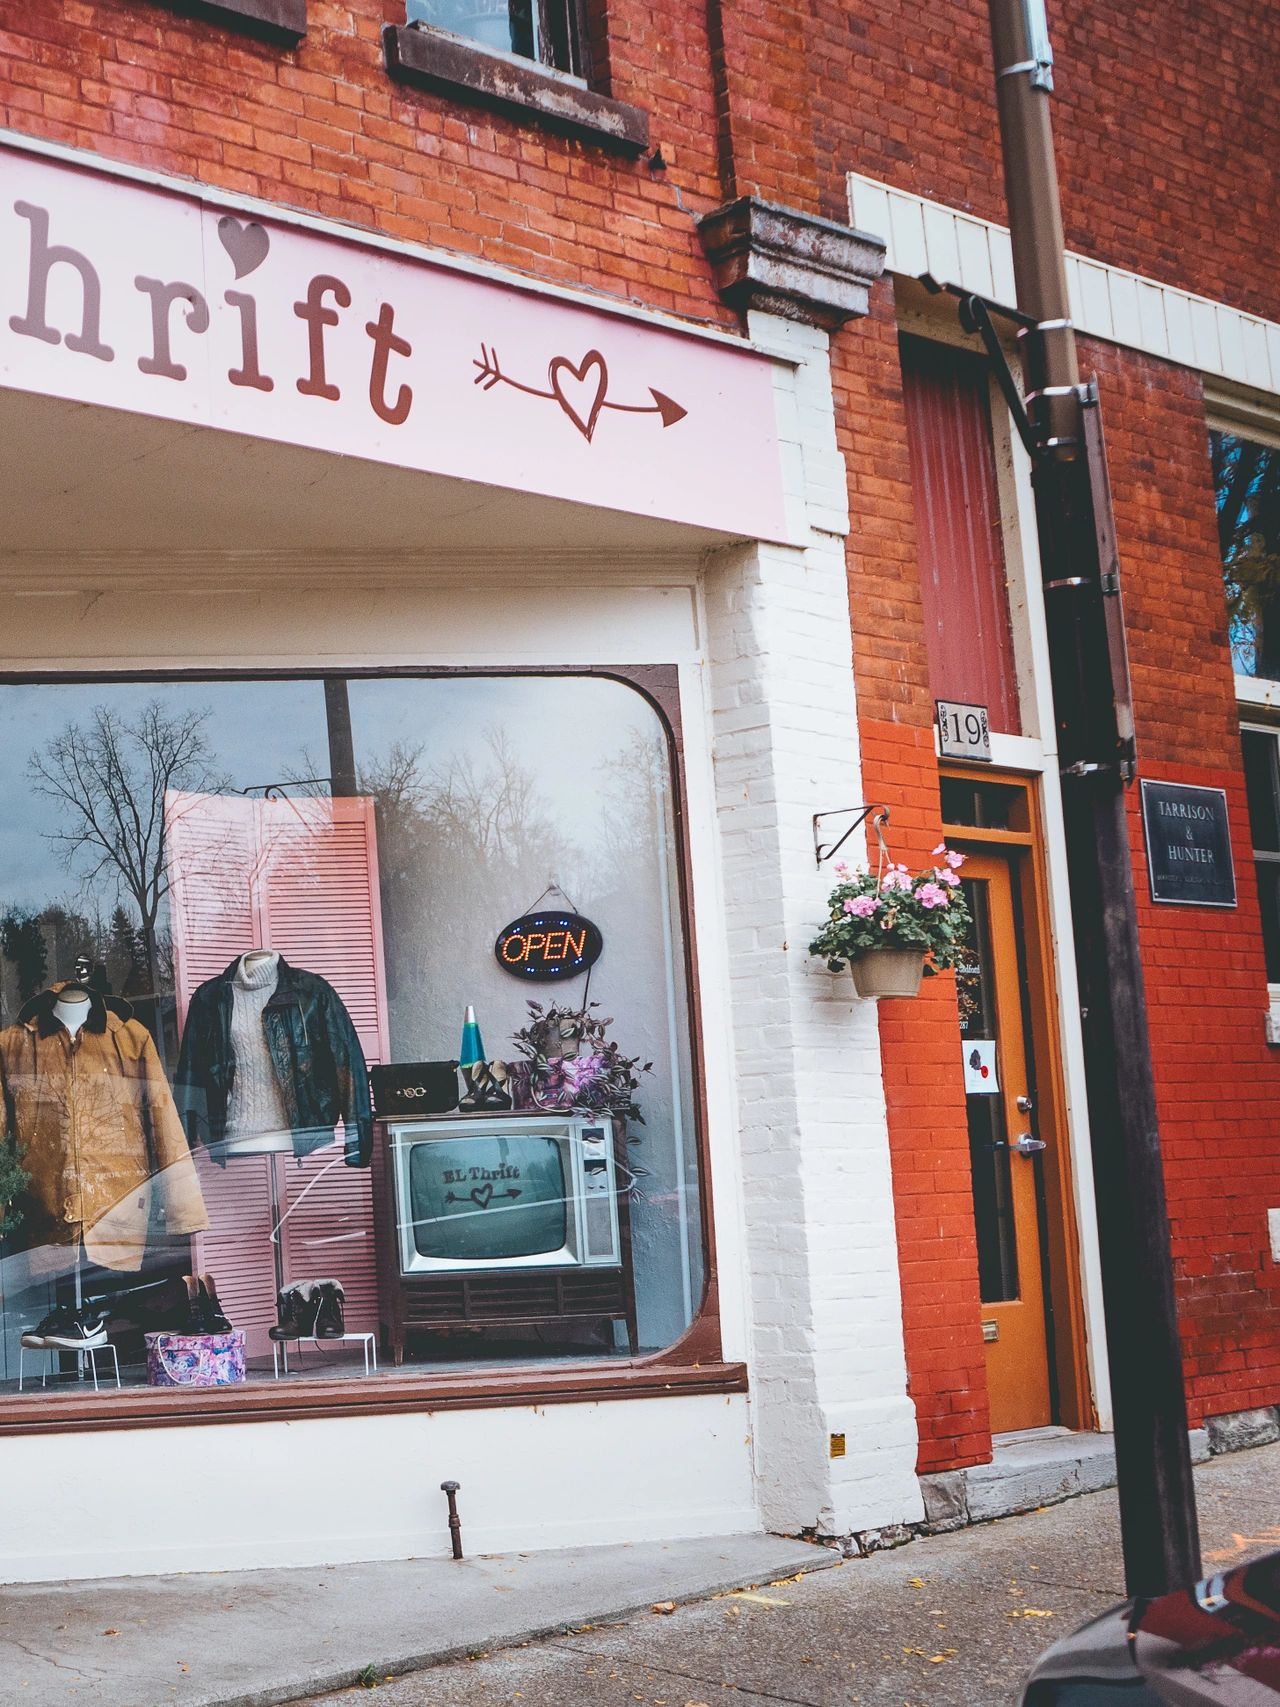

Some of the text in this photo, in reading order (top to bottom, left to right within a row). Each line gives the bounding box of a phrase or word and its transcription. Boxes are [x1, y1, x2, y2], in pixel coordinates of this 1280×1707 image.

[949, 713, 981, 745] 19
[1158, 801, 1215, 821] TARRISON
[1185, 825, 1194, 841] &
[1168, 845, 1215, 864] HUNTER
[502, 929, 587, 963] OPEN
[442, 1163, 520, 1184] EL Thrift
